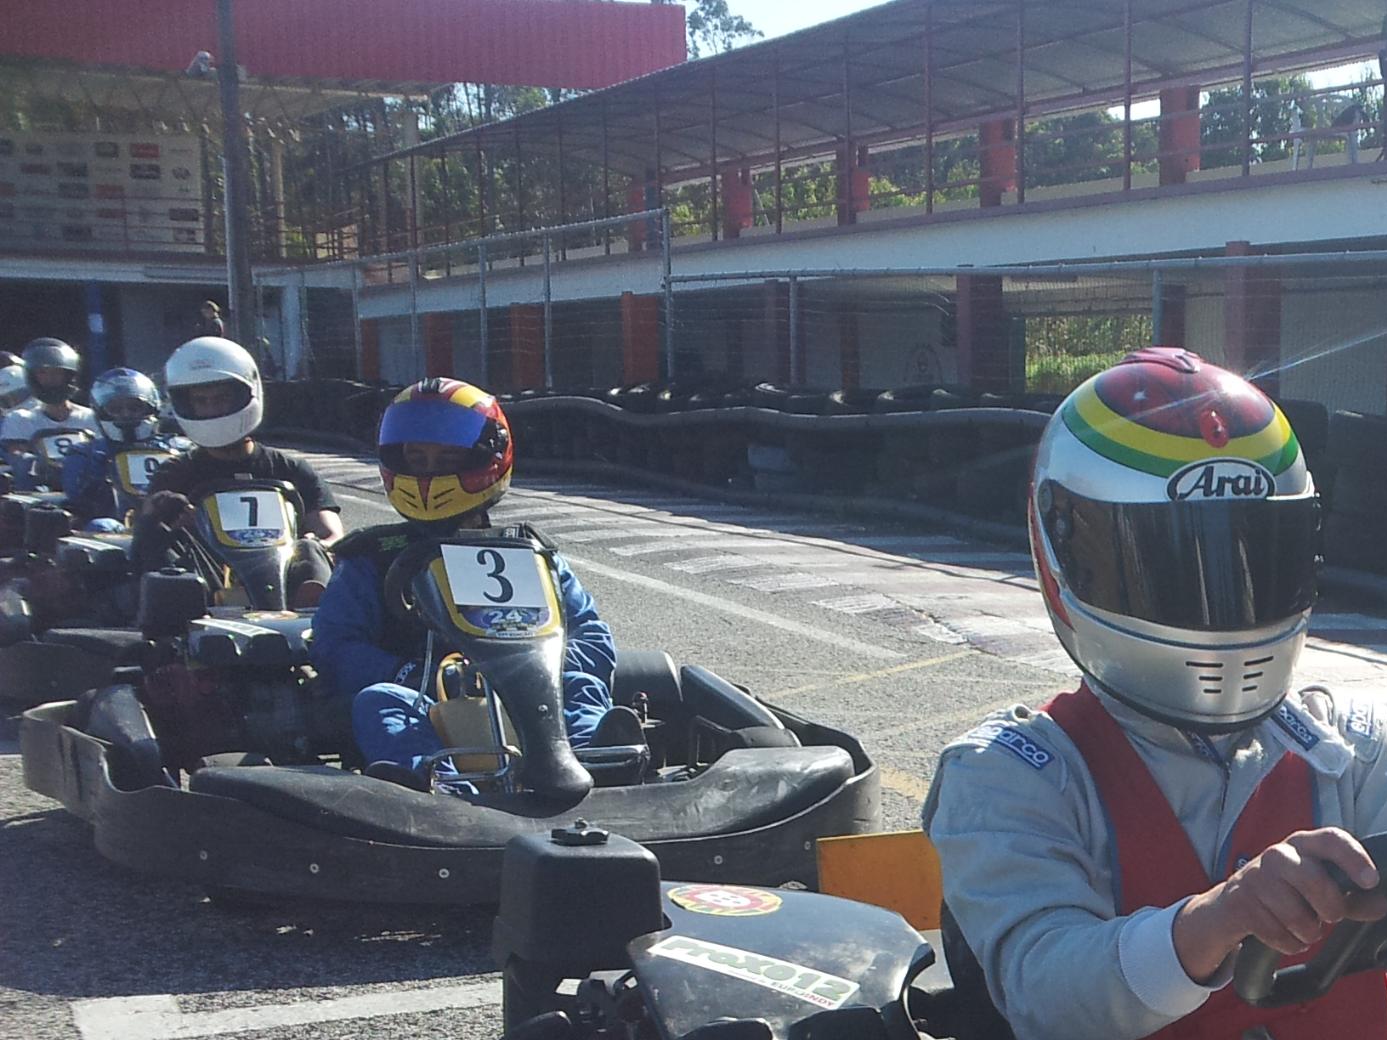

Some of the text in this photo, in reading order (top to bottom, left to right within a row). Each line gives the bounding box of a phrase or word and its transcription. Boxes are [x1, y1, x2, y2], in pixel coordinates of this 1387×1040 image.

[1177, 465, 1264, 500] Arai
[476, 548, 514, 604] 3
[489, 609, 523, 624] 24
[982, 725, 1049, 766] parco
